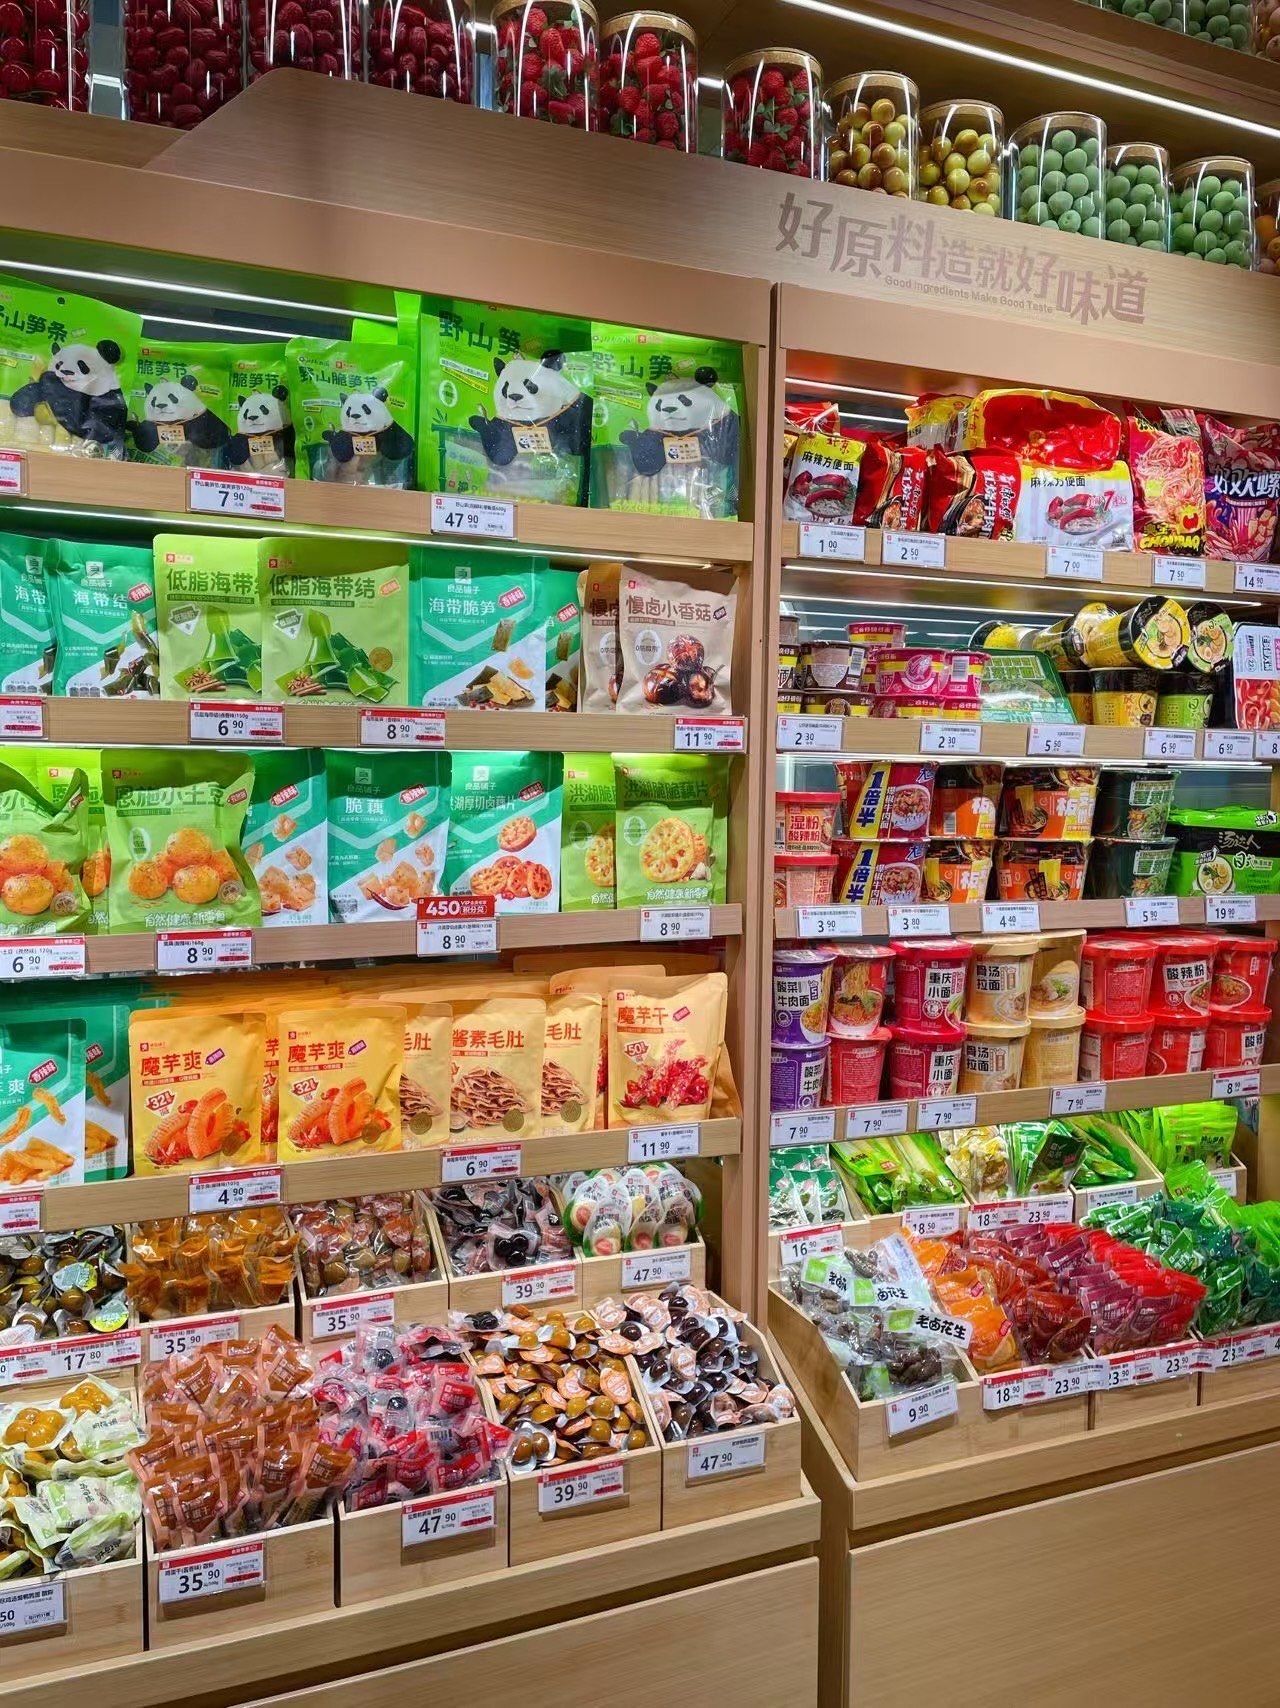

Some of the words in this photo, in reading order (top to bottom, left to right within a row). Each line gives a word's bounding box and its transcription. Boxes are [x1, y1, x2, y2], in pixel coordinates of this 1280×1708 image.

[775, 192, 1148, 325] 好原料造就好味道
[885, 275, 912, 289] Good
[914, 280, 969, 300] Ingredients
[971, 290, 997, 304] Make
[1000, 295, 1025, 309] Good
[1027, 299, 1053, 314] Taste
[438, 310, 522, 355] 野山笋
[137, 360, 188, 379] 脆笋节
[593, 351, 673, 378] 野山笋
[231, 370, 279, 388] 脆笋节
[801, 450, 854, 472] 麻辣方便面
[218, 491, 230, 507] 7
[233, 492, 245, 501] 90
[445, 513, 464, 528] 47
[467, 514, 479, 524] 90
[819, 540, 825, 553] 1
[900, 547, 908, 560] 2
[910, 548, 919, 557] 50
[1064, 560, 1070, 573] 7
[1072, 561, 1080, 569] 00
[166, 568, 261, 596] 低脂海带
[1169, 570, 1175, 582] 7
[1243, 576, 1255, 588] 14
[1257, 577, 1264, 585] 90
[269, 573, 376, 600] 低脂海带结
[73, 590, 128, 610] 海带结
[428, 598, 496, 616] 海带脆笋
[626, 595, 711, 622] 慢卤小香菇
[218, 720, 228, 736] 6
[232, 720, 243, 729] 90
[387, 724, 397, 740] 8
[400, 724, 410, 733] 90
[685, 732, 699, 746] 11
[795, 732, 802, 745] 2
[805, 733, 814, 741] 30
[938, 736, 945, 749] 2
[1044, 740, 1051, 752] 5
[1161, 742, 1167, 754] 6
[1219, 743, 1225, 754] 6
[1272, 743, 1278, 754] 8
[345, 797, 384, 815] 脆藕
[858, 771, 884, 828] 1倍半
[879, 786, 895, 829] 爆椒牛肉面
[791, 815, 819, 831] 湿粉
[788, 830, 820, 843] 酸辣粉
[1218, 831, 1261, 850] 汤达人
[846, 848, 873, 903] 1倍半
[426, 901, 460, 915] 450
[1215, 907, 1226, 919] 19
[1228, 908, 1235, 916] 90
[902, 918, 910, 930] 3
[911, 918, 920, 926] 80
[1000, 915, 1006, 928] 4
[1008, 916, 1017, 924] 40
[1142, 911, 1149, 922] 5
[660, 923, 668, 936] 8
[671, 923, 680, 931] 90
[817, 920, 825, 933] 3
[827, 920, 836, 929] 90
[443, 935, 451, 949] 8
[455, 935, 466, 943] 90
[187, 948, 198, 964] 8
[202, 948, 213, 956] 90
[12, 956, 24, 973] 6
[28, 956, 41, 965] 90
[976, 964, 1000, 978] 骨汤
[929, 971, 951, 985] 重庆
[1166, 965, 1206, 981] 酸辣粉
[776, 981, 798, 995] 酸菜
[928, 986, 951, 1000] 小面
[976, 978, 1000, 992] 拉面
[777, 994, 810, 1008] 牛肉面
[617, 1006, 669, 1025] 魔芋干
[452, 1029, 525, 1050] 酱素毛肚
[546, 1022, 582, 1042] 毛肚
[288, 1040, 345, 1063] 魔芋爽
[966, 1045, 989, 1059] 骨汤
[140, 1050, 202, 1077] 魔芋爽
[934, 1055, 954, 1068] 重庆
[966, 1058, 989, 1072] 拉面
[32, 1061, 57, 1083] 香辣味
[933, 1068, 952, 1081] 小面
[296, 1082, 311, 1096] 32
[1226, 1083, 1233, 1094] 8
[151, 1093, 165, 1109] 32
[1067, 1099, 1074, 1110] 7
[1076, 1099, 1083, 1107] 90
[864, 1120, 870, 1132] 7
[873, 1119, 882, 1127] 90
[935, 1113, 941, 1125] 7
[943, 1112, 952, 1120] 90
[789, 1127, 796, 1139] 7
[799, 1126, 808, 1135] 90
[641, 1143, 656, 1157] 11
[660, 1141, 670, 1149] 90
[466, 1162, 475, 1176] 6
[478, 1160, 488, 1168] 90
[217, 1189, 229, 1205] 4
[233, 1188, 244, 1196] 90
[978, 1214, 990, 1227] 18
[1028, 1210, 1041, 1223] 23
[792, 1242, 807, 1257] 16
[633, 1269, 650, 1282] 47
[652, 1267, 662, 1276] 90
[515, 1284, 533, 1299] 39
[536, 1281, 545, 1289] 90
[328, 1315, 346, 1332] 35
[349, 1313, 360, 1321] 90
[915, 1314, 968, 1341] 老卤花生
[165, 1337, 186, 1355] 35
[64, 1353, 86, 1371] 17
[90, 1350, 101, 1359] 80
[1166, 1359, 1180, 1373] 23
[1181, 1356, 1189, 1365] 90
[1055, 1380, 1069, 1394] 23
[1071, 1377, 1080, 1386] 90
[996, 1389, 1010, 1403] 18
[1012, 1385, 1021, 1394] 90
[908, 1408, 917, 1422] 9
[918, 1403, 929, 1413] 90
[701, 1455, 719, 1471] 47
[721, 1452, 733, 1462] 90
[554, 1484, 574, 1504] 39
[577, 1481, 588, 1490] 90
[418, 1515, 441, 1535] 47
[445, 1512, 456, 1522] 90
[178, 1573, 203, 1594] 35
[208, 1569, 220, 1579] 90
[0, 1610, 15, 1622] 50
